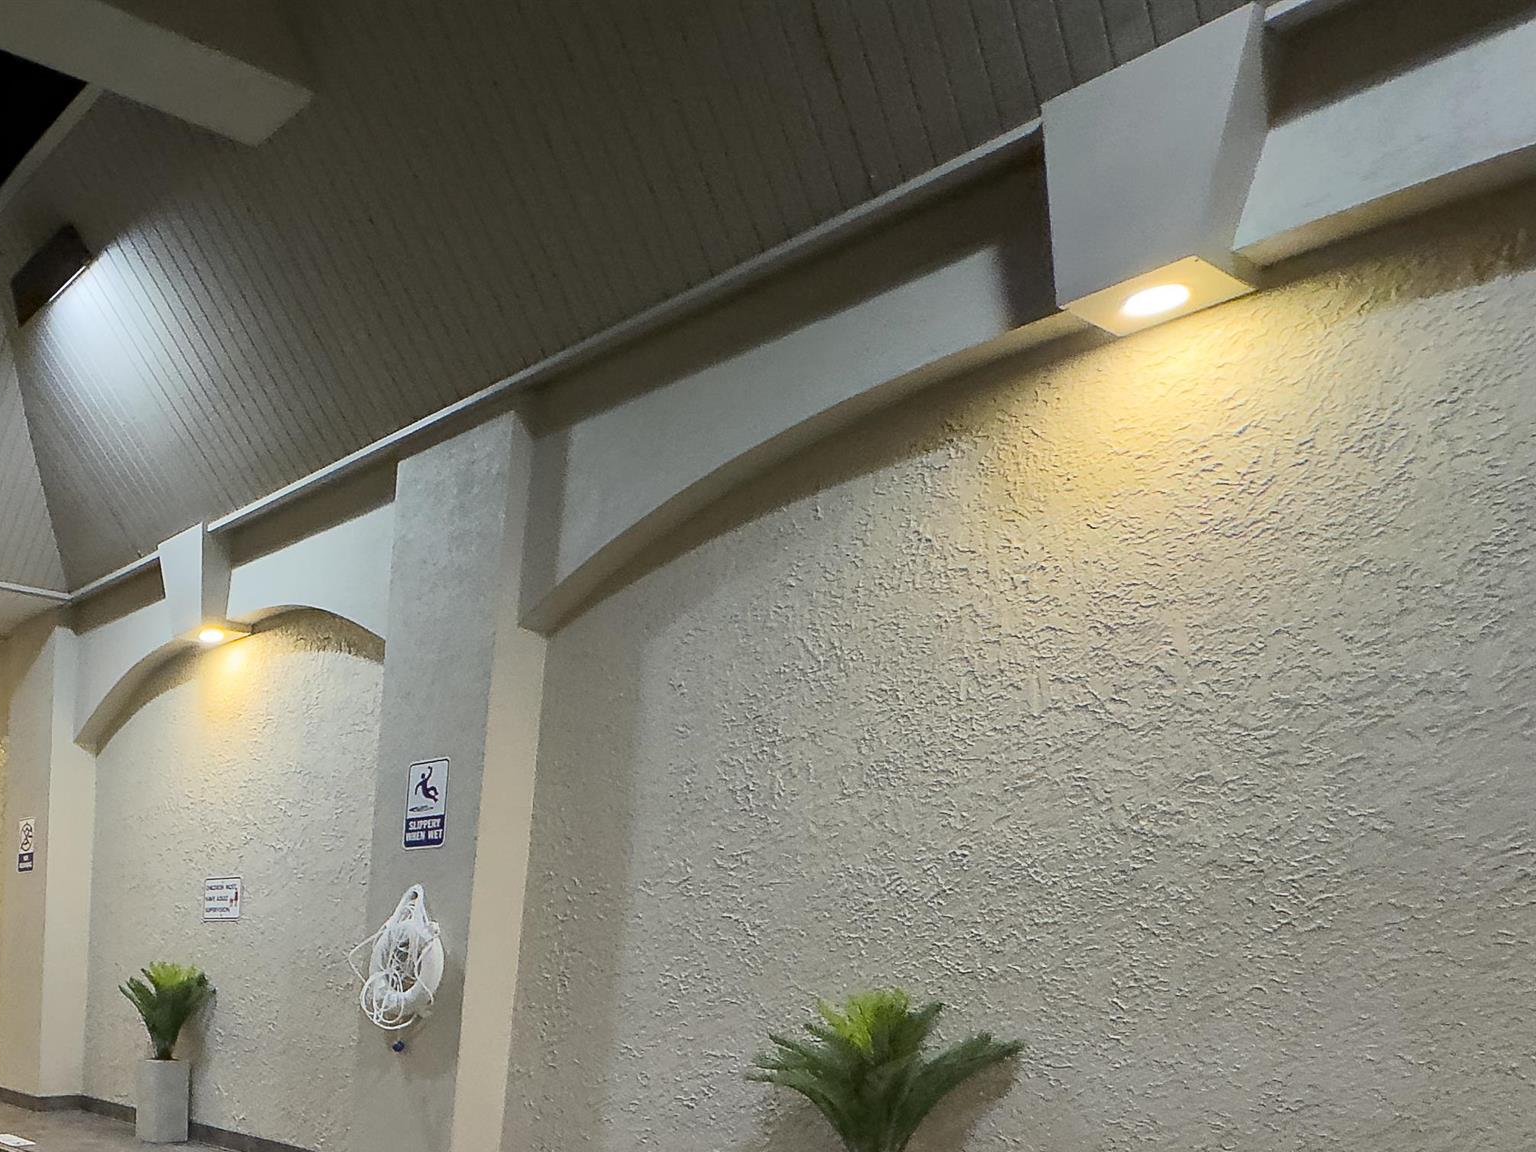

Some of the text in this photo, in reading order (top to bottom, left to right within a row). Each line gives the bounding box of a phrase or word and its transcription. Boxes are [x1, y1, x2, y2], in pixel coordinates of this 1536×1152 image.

[408, 818, 441, 830] SLIPPERY
[405, 829, 444, 842] WHEN WET
